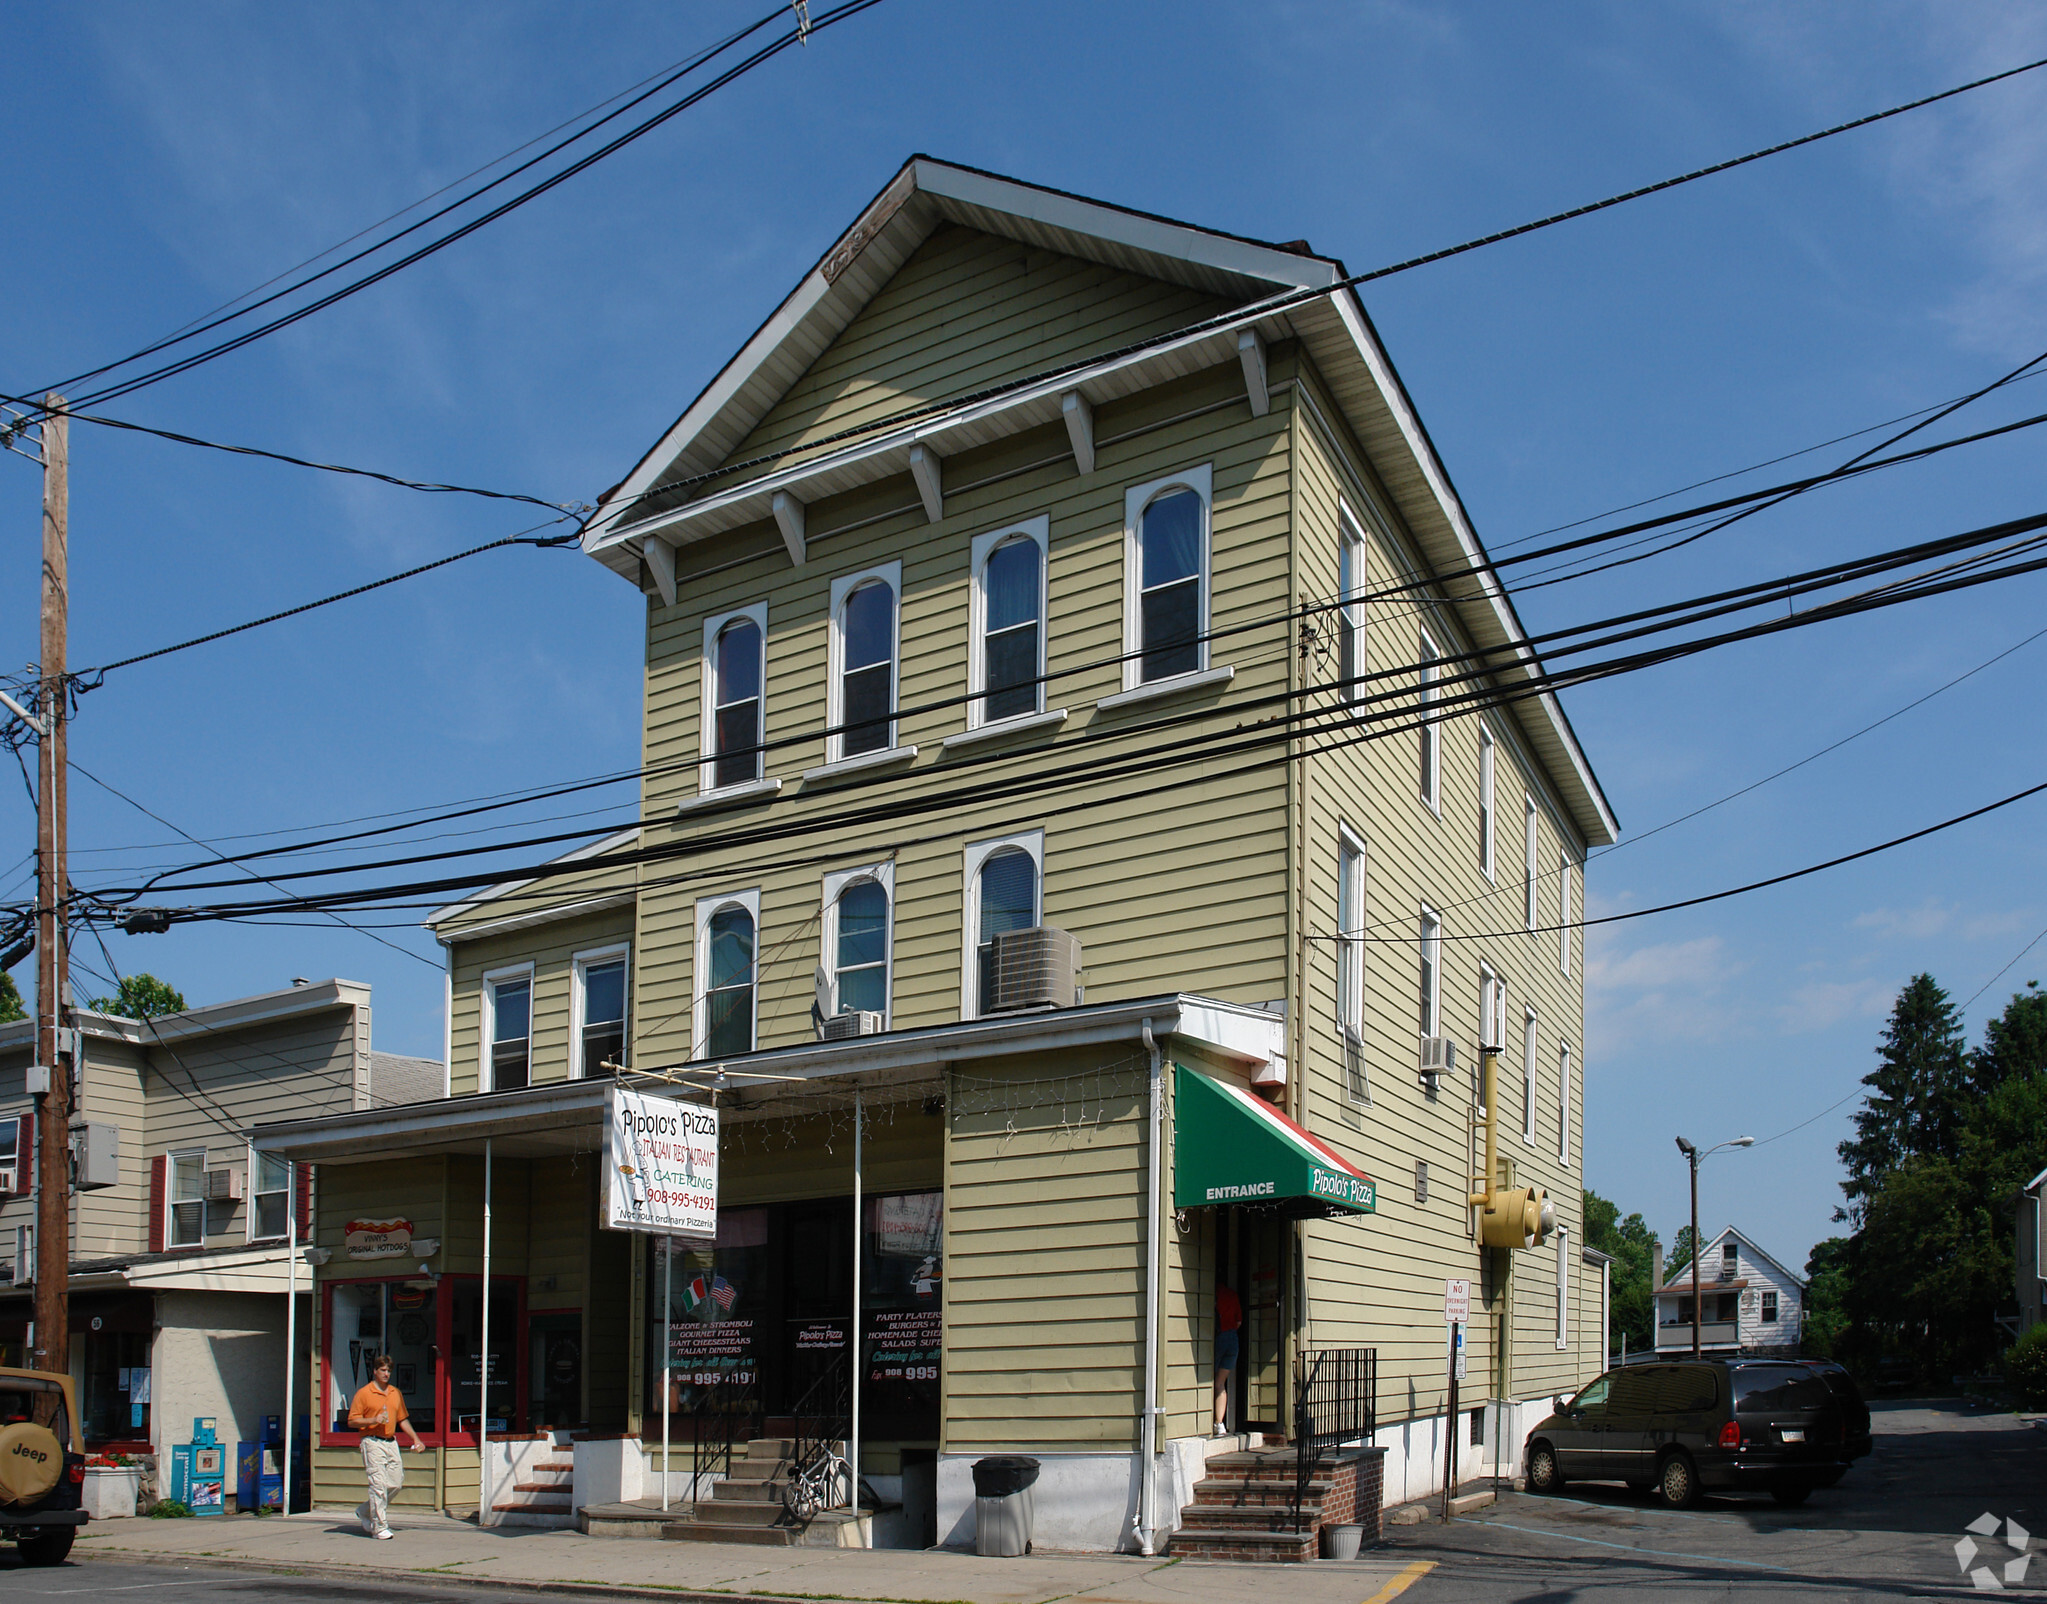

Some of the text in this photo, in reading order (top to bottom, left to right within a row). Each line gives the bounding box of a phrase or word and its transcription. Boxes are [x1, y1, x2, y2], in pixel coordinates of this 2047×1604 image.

[622, 1110, 716, 1137] Pipolo's Pizza
[643, 1139, 715, 1168] ITALIAN RESTAURANT
[654, 1169, 713, 1190] CATERING
[1206, 1182, 1275, 1200] ENTRANCE
[1312, 1168, 1373, 1205] Pipolo's Pizza
[647, 1189, 715, 1210] 908-995-4191
[637, 1213, 653, 1223] your
[655, 1216, 685, 1226] ordinary
[364, 1234, 388, 1242] VINNY'S
[348, 1242, 408, 1254] ORIGINAL HOTDOGS
[1453, 1285, 1463, 1294] NO
[875, 1313, 904, 1322] PARTY
[710, 1320, 753, 1329] STROMBOLI
[888, 1321, 929, 1330] BURGERS
[680, 1329, 740, 1338] GOURMET PIZZA
[868, 1331, 918, 1339] HOMEMADE
[669, 1337, 751, 1347] GIANT CHEESESTEAKS
[881, 1339, 917, 1348] SALADS
[677, 1346, 742, 1355] ITALIAN DINNERS
[694, 1372, 721, 1385] 995
[885, 1368, 902, 1376] 908
[905, 1366, 937, 1380] 995
[12, 1443, 47, 1463] Jeep
[181, 1455, 190, 1503] Democrat
